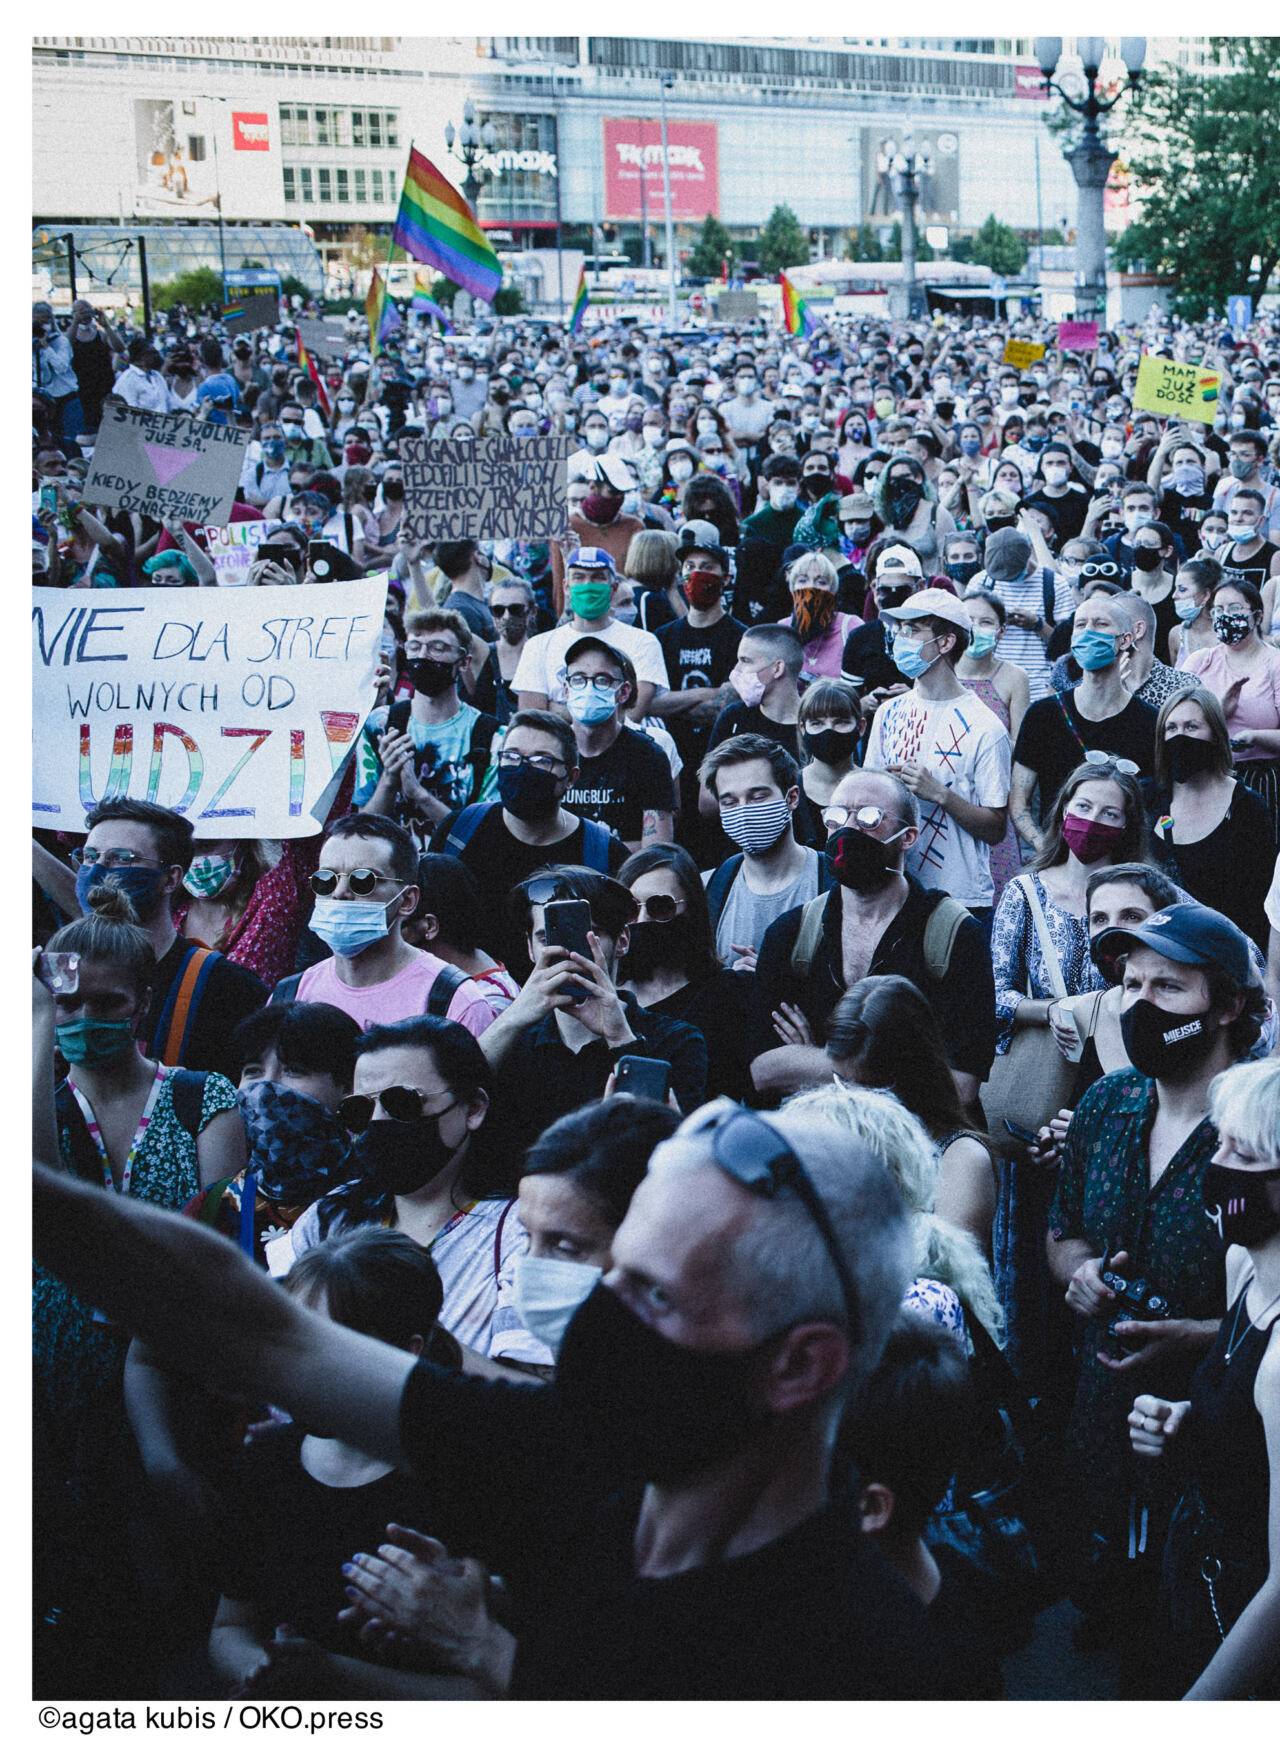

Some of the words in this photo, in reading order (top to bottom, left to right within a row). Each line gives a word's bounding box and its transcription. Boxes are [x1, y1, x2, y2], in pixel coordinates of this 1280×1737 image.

[1163, 365, 1196, 378] MAM
[113, 408, 186, 432] STREFY
[189, 420, 246, 446] WOLNE
[92, 472, 141, 495] KIEDY
[402, 486, 486, 510] PRZEMOCY
[489, 486, 522, 510] TAK
[32, 606, 145, 666] NIE
[153, 622, 230, 662] DLA
[248, 615, 373, 663] STREF
[67, 680, 219, 719] WOLNYCH
[242, 673, 296, 710] OD
[1163, 1019, 1202, 1041] MIEJSCE
